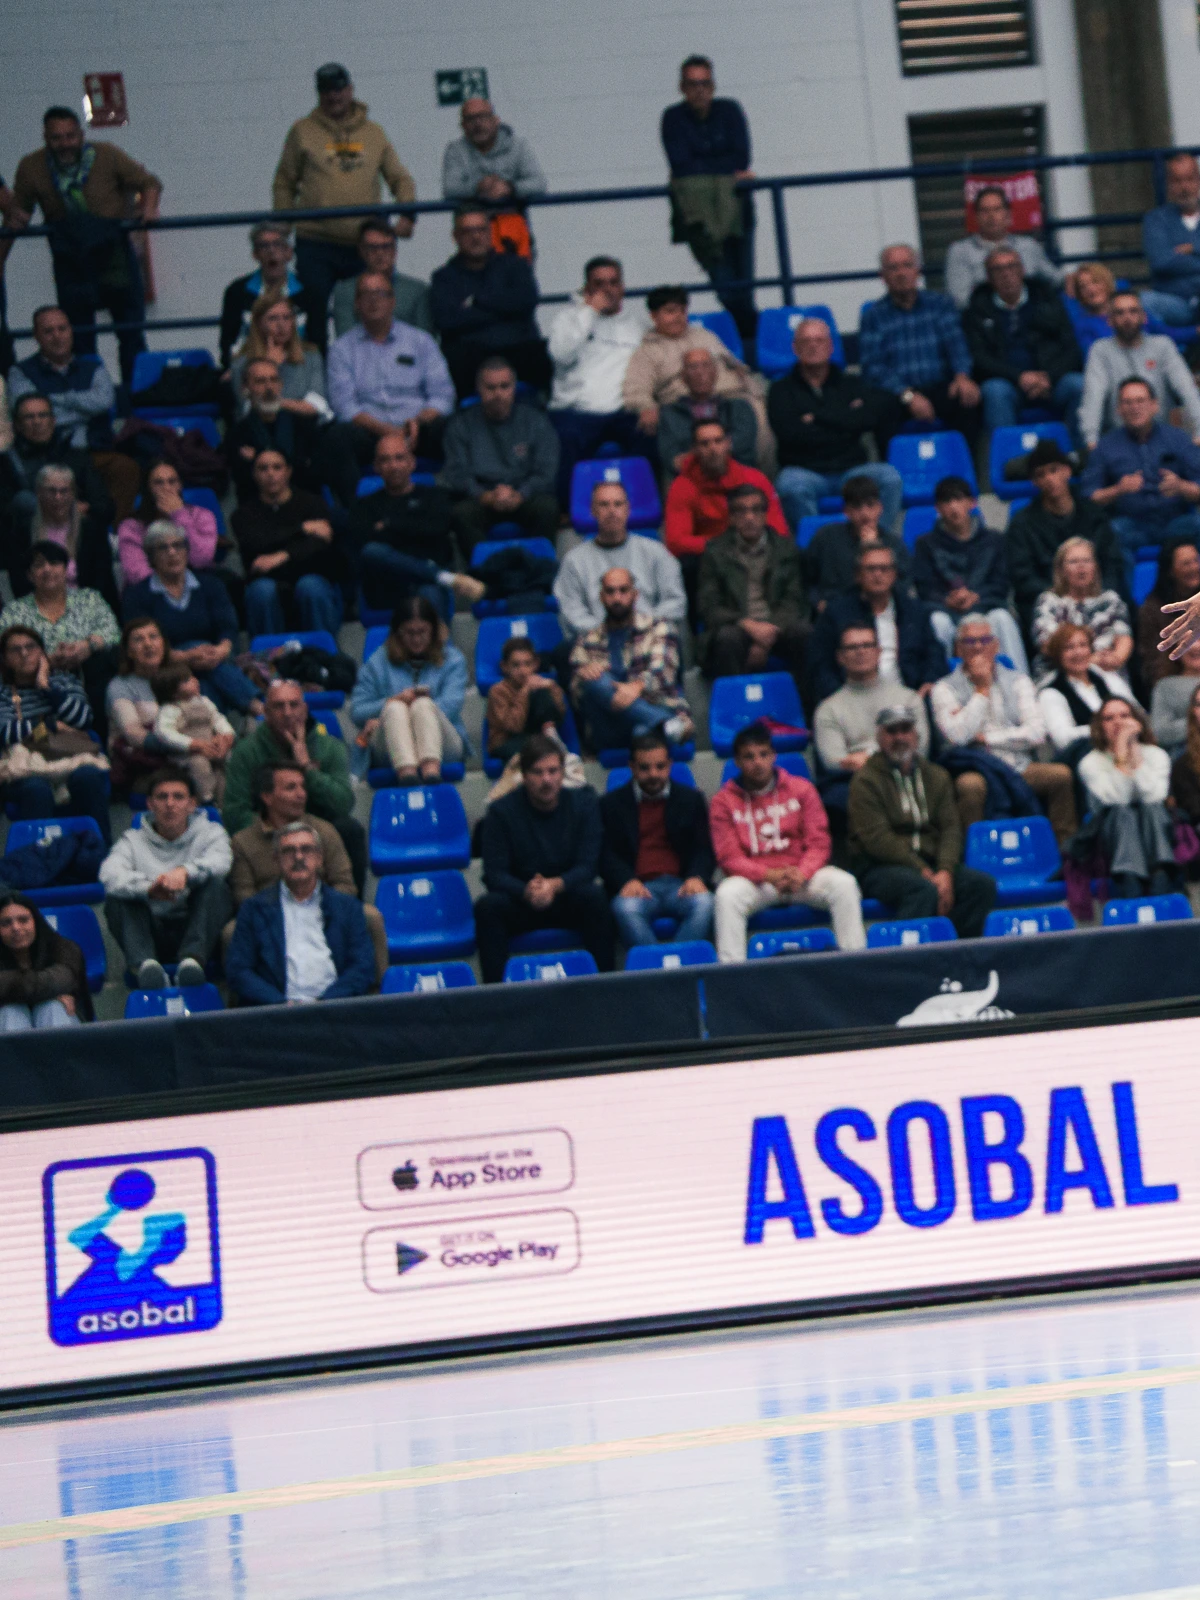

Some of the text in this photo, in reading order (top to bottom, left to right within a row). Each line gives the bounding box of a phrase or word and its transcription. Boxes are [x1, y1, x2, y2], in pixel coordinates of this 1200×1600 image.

[429, 1163, 543, 1190] App Store
[745, 1082, 1178, 1244] ASOBAL
[440, 1241, 560, 1268] Google Play
[77, 1295, 195, 1335] asobal
